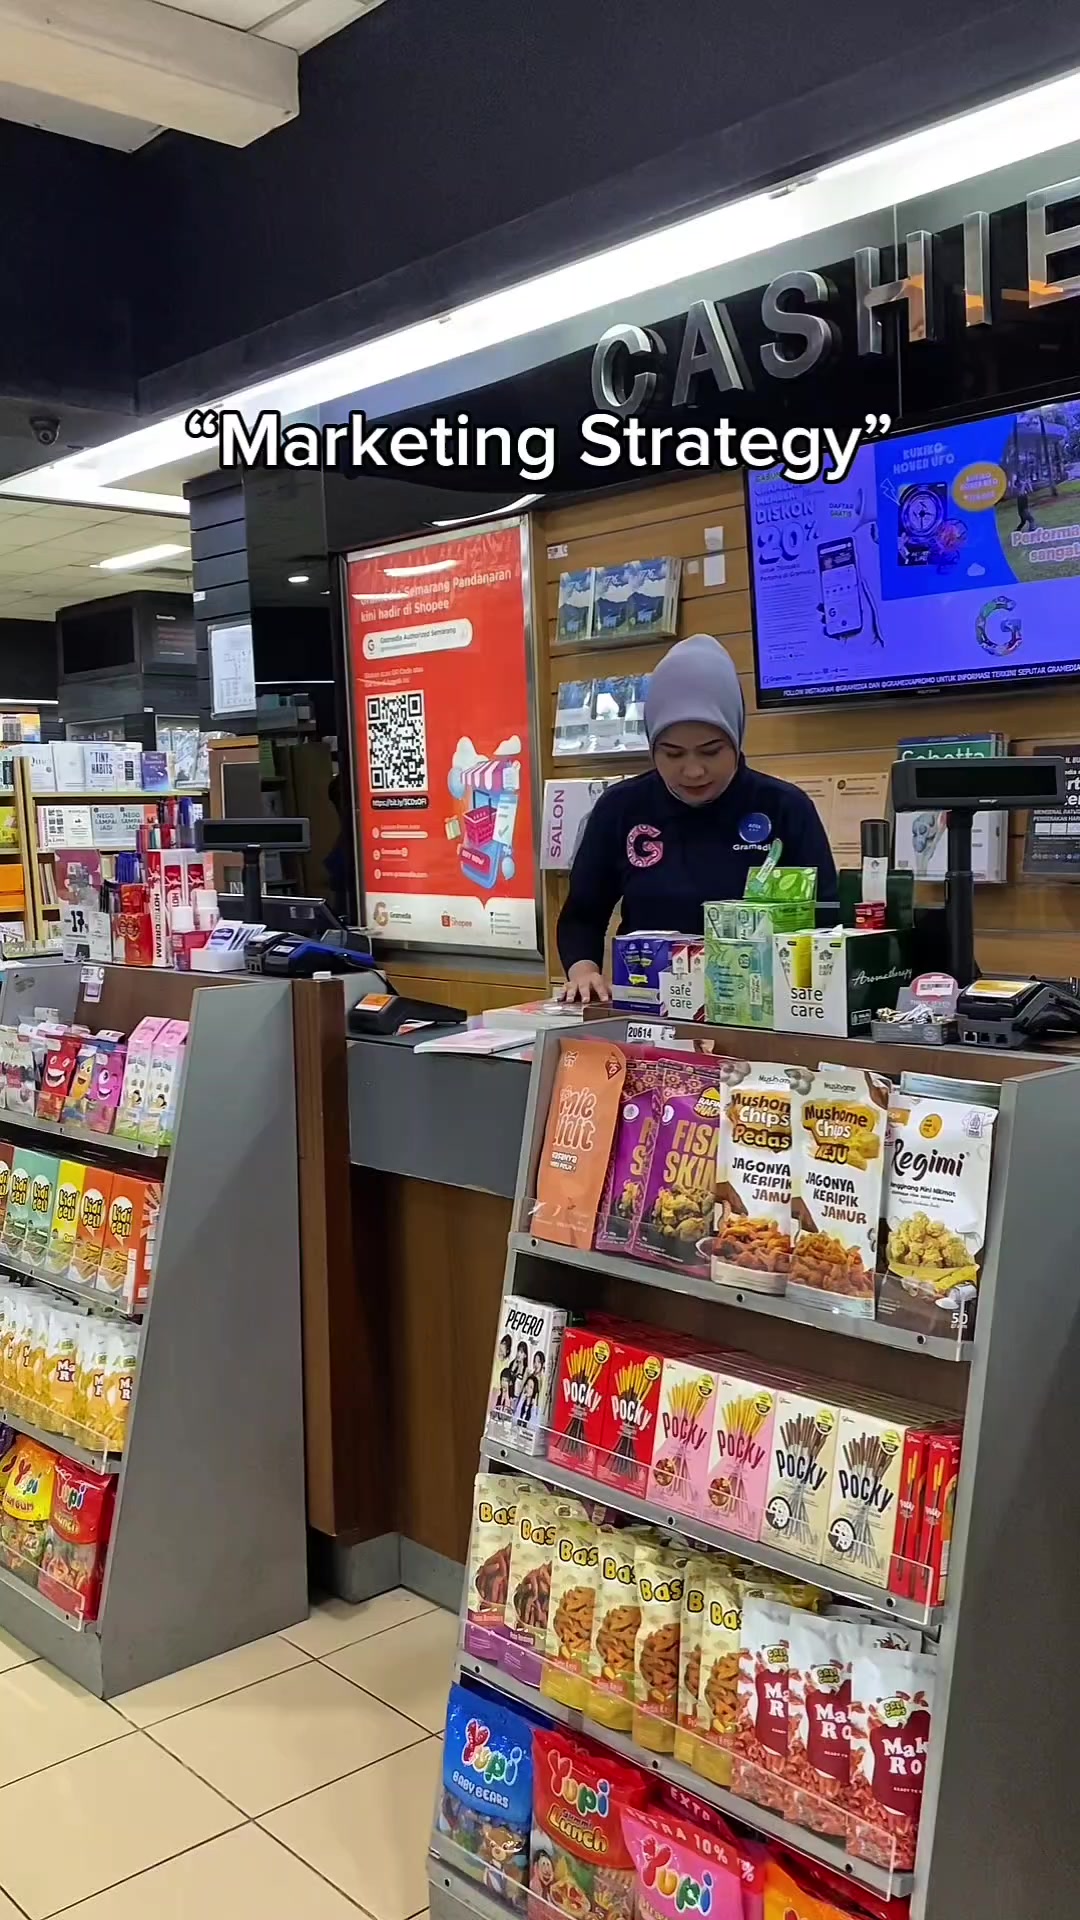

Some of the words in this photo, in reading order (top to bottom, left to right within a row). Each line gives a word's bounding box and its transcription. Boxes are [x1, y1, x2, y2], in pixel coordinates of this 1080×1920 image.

[931, 453, 955, 468] UFO
[755, 502, 814, 525] DISKON
[757, 520, 820, 566] 20%
[404, 580, 450, 599] Semarang
[452, 569, 512, 589] Pandanaran
[360, 609, 377, 622] kini
[378, 605, 401, 619] hadir
[403, 603, 412, 615] di
[414, 599, 449, 615] Shopee
[91, 763, 112, 775] HABITS
[95, 752, 109, 763] TINY
[550, 788, 565, 858] SALON
[627, 824, 664, 867] G
[852, 966, 912, 987] Aromatherapy
[670, 984, 691, 996] safe
[790, 987, 823, 1002] safe
[670, 998, 693, 1009] care
[790, 1004, 825, 1019] care
[627, 1026, 652, 1039] 20614
[739, 1105, 791, 1128] Chips
[805, 1106, 868, 1128] Mushome
[733, 1124, 791, 1149] Pedas
[815, 1119, 851, 1138] Chips
[815, 1143, 849, 1164] KEJU
[891, 1139, 966, 1181] Regimi
[732, 1158, 791, 1177] JAGONYA
[805, 1172, 855, 1194] JAGONYA
[752, 1188, 791, 1204] JAMU
[813, 1188, 859, 1208] KERIPIK
[821, 1205, 867, 1224] JAMUR
[505, 1309, 545, 1338] PEPERO
[479, 1502, 517, 1526] Bas
[520, 1519, 556, 1547] Bas
[559, 1539, 599, 1567] Bas
[640, 1579, 684, 1602] Bas
[764, 1682, 789, 1703] Ma
[461, 1717, 522, 1787] Yupi
[881, 1736, 930, 1758] Mak
[452, 1770, 476, 1796] BABY
[475, 1785, 510, 1810] BEARS
[548, 1749, 612, 1818] Yupi
[549, 1803, 609, 1853] Lunch
[693, 1833, 729, 1865] 10%
[641, 1835, 713, 1915] Yupi
